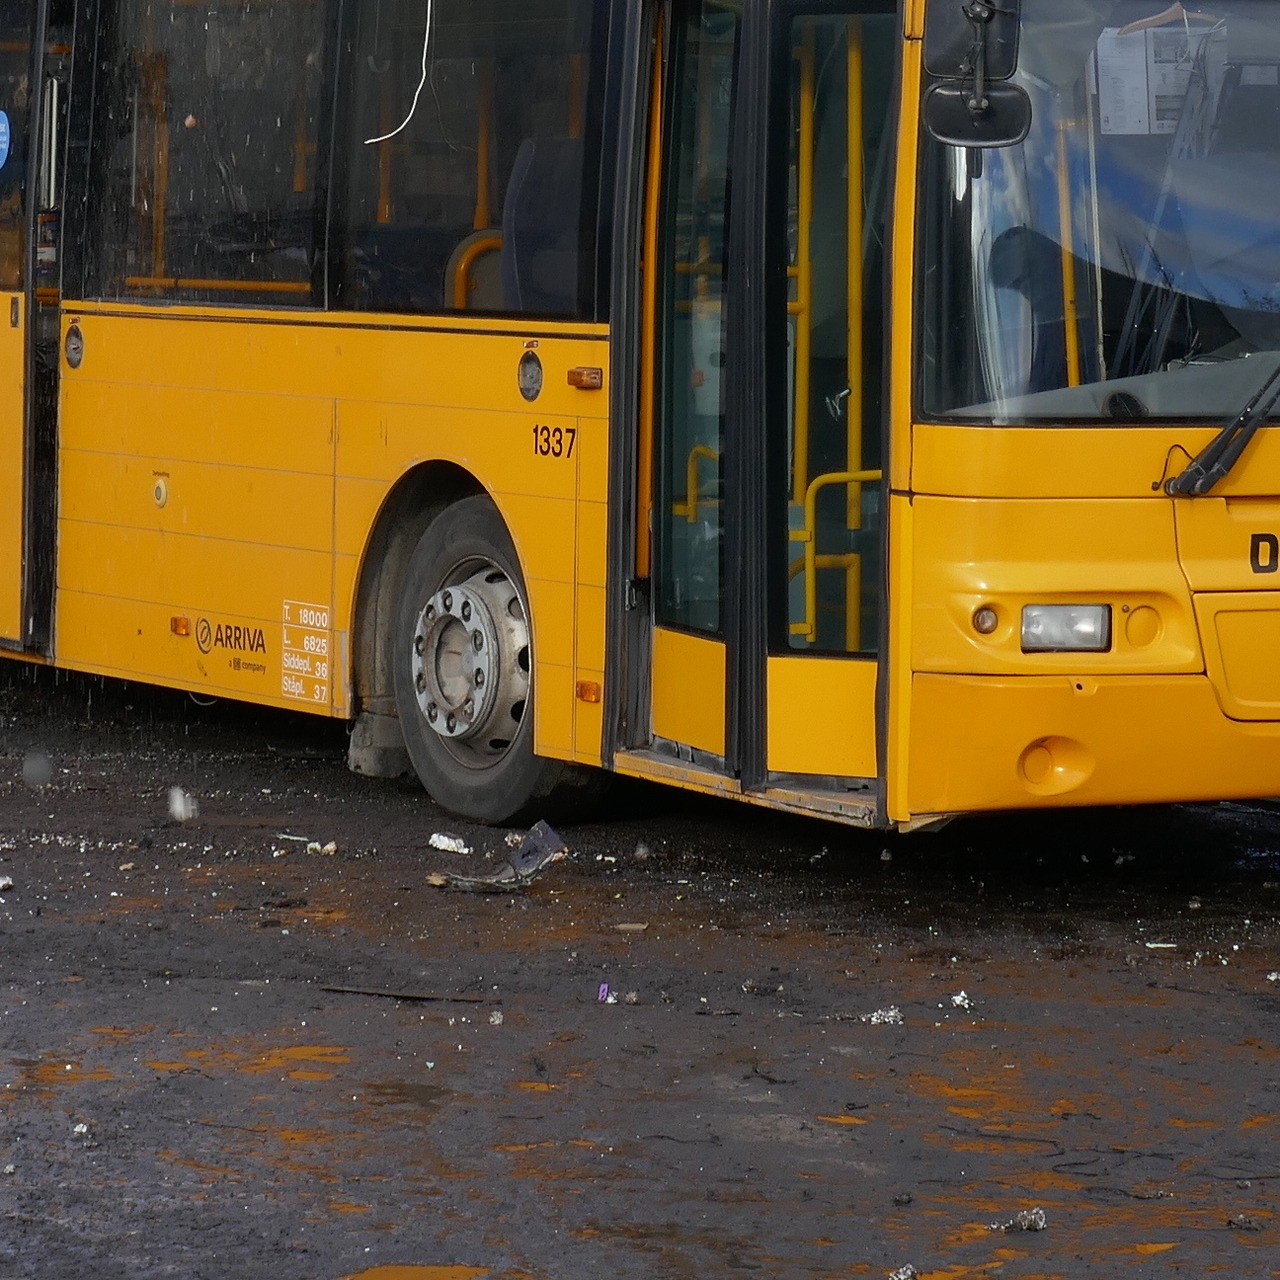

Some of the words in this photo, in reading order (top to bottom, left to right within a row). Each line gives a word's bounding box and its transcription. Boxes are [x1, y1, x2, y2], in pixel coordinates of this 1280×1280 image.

[533, 424, 576, 459] 1337
[299, 608, 328, 628] 18000
[214, 623, 266, 654] ARRIVA
[303, 635, 328, 654] 6825
[242, 661, 266, 675] company
[282, 652, 312, 674] Siddepl.
[315, 661, 328, 678] 36
[282, 675, 305, 698] Ståpl.
[313, 684, 327, 700] 37
